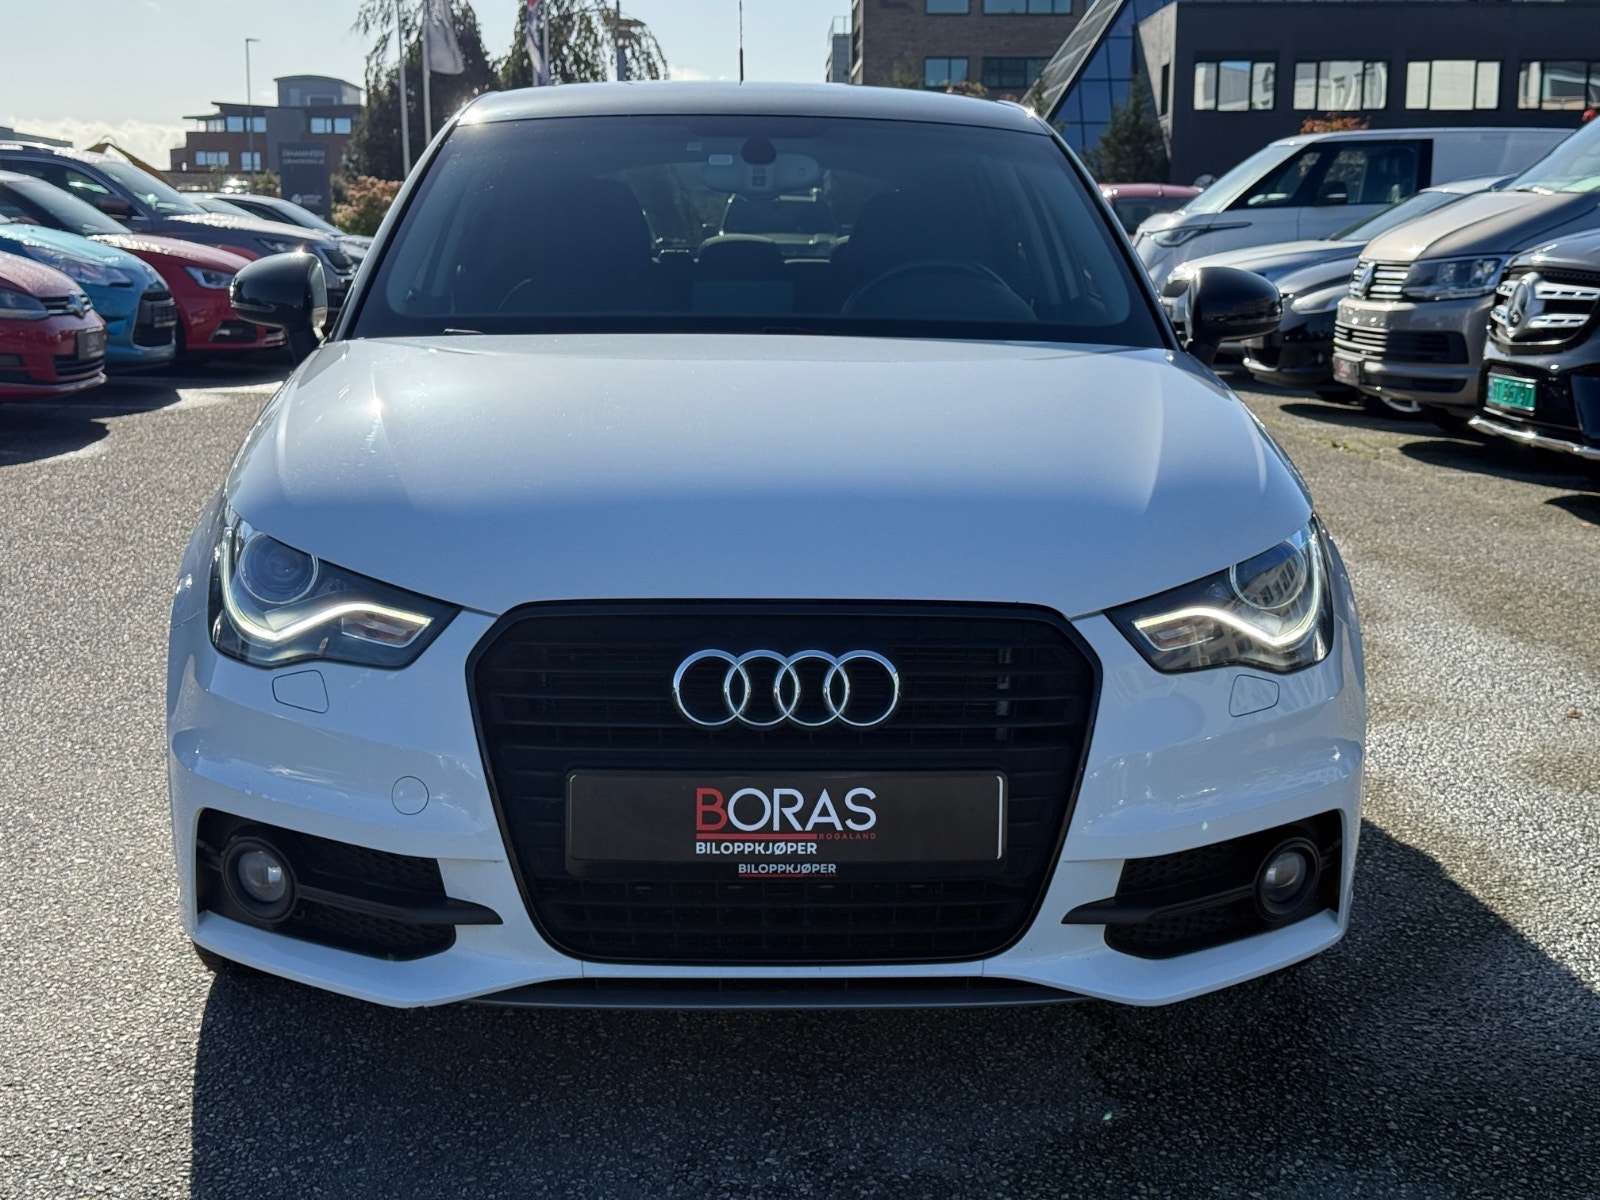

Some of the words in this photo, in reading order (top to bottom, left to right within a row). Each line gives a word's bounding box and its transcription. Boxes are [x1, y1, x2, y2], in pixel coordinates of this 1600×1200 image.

[696, 788, 877, 831] BORAS
[695, 842, 818, 855] BILOPPKJØPER
[738, 863, 837, 874] BILOPPKJØPER
